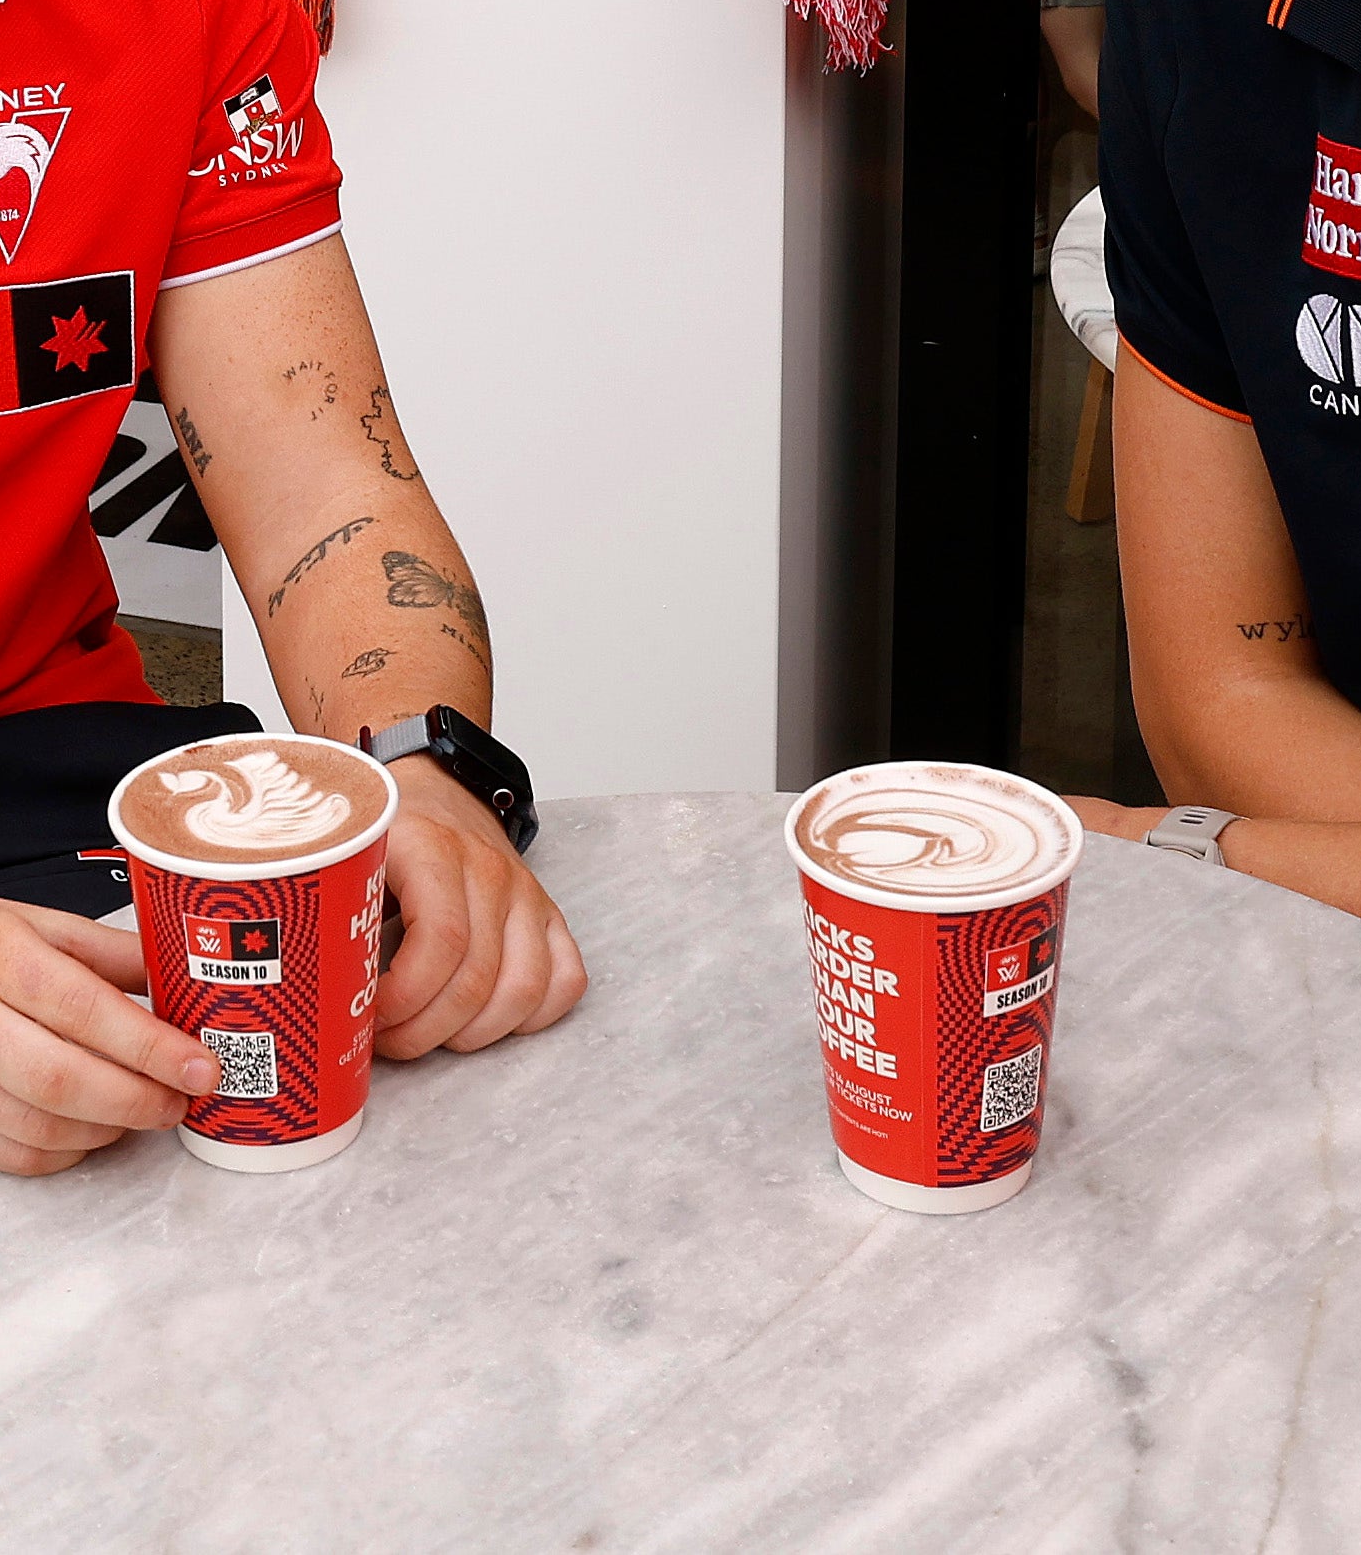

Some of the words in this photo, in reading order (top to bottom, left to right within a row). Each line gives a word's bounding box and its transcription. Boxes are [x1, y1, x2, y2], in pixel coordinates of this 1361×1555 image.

[282, 359, 324, 380] WAIT
[324, 371, 338, 404] FOR
[201, 961, 249, 980] SEASON
[253, 964, 268, 980] 10
[806, 928, 900, 998] ARDER
[996, 981, 1038, 1009] SEASON
[816, 1019, 899, 1080] OFFEE
[835, 1082, 878, 1114] TICKETS
[879, 1104, 914, 1124] NOW
[845, 1079, 893, 1107] AUGUST
